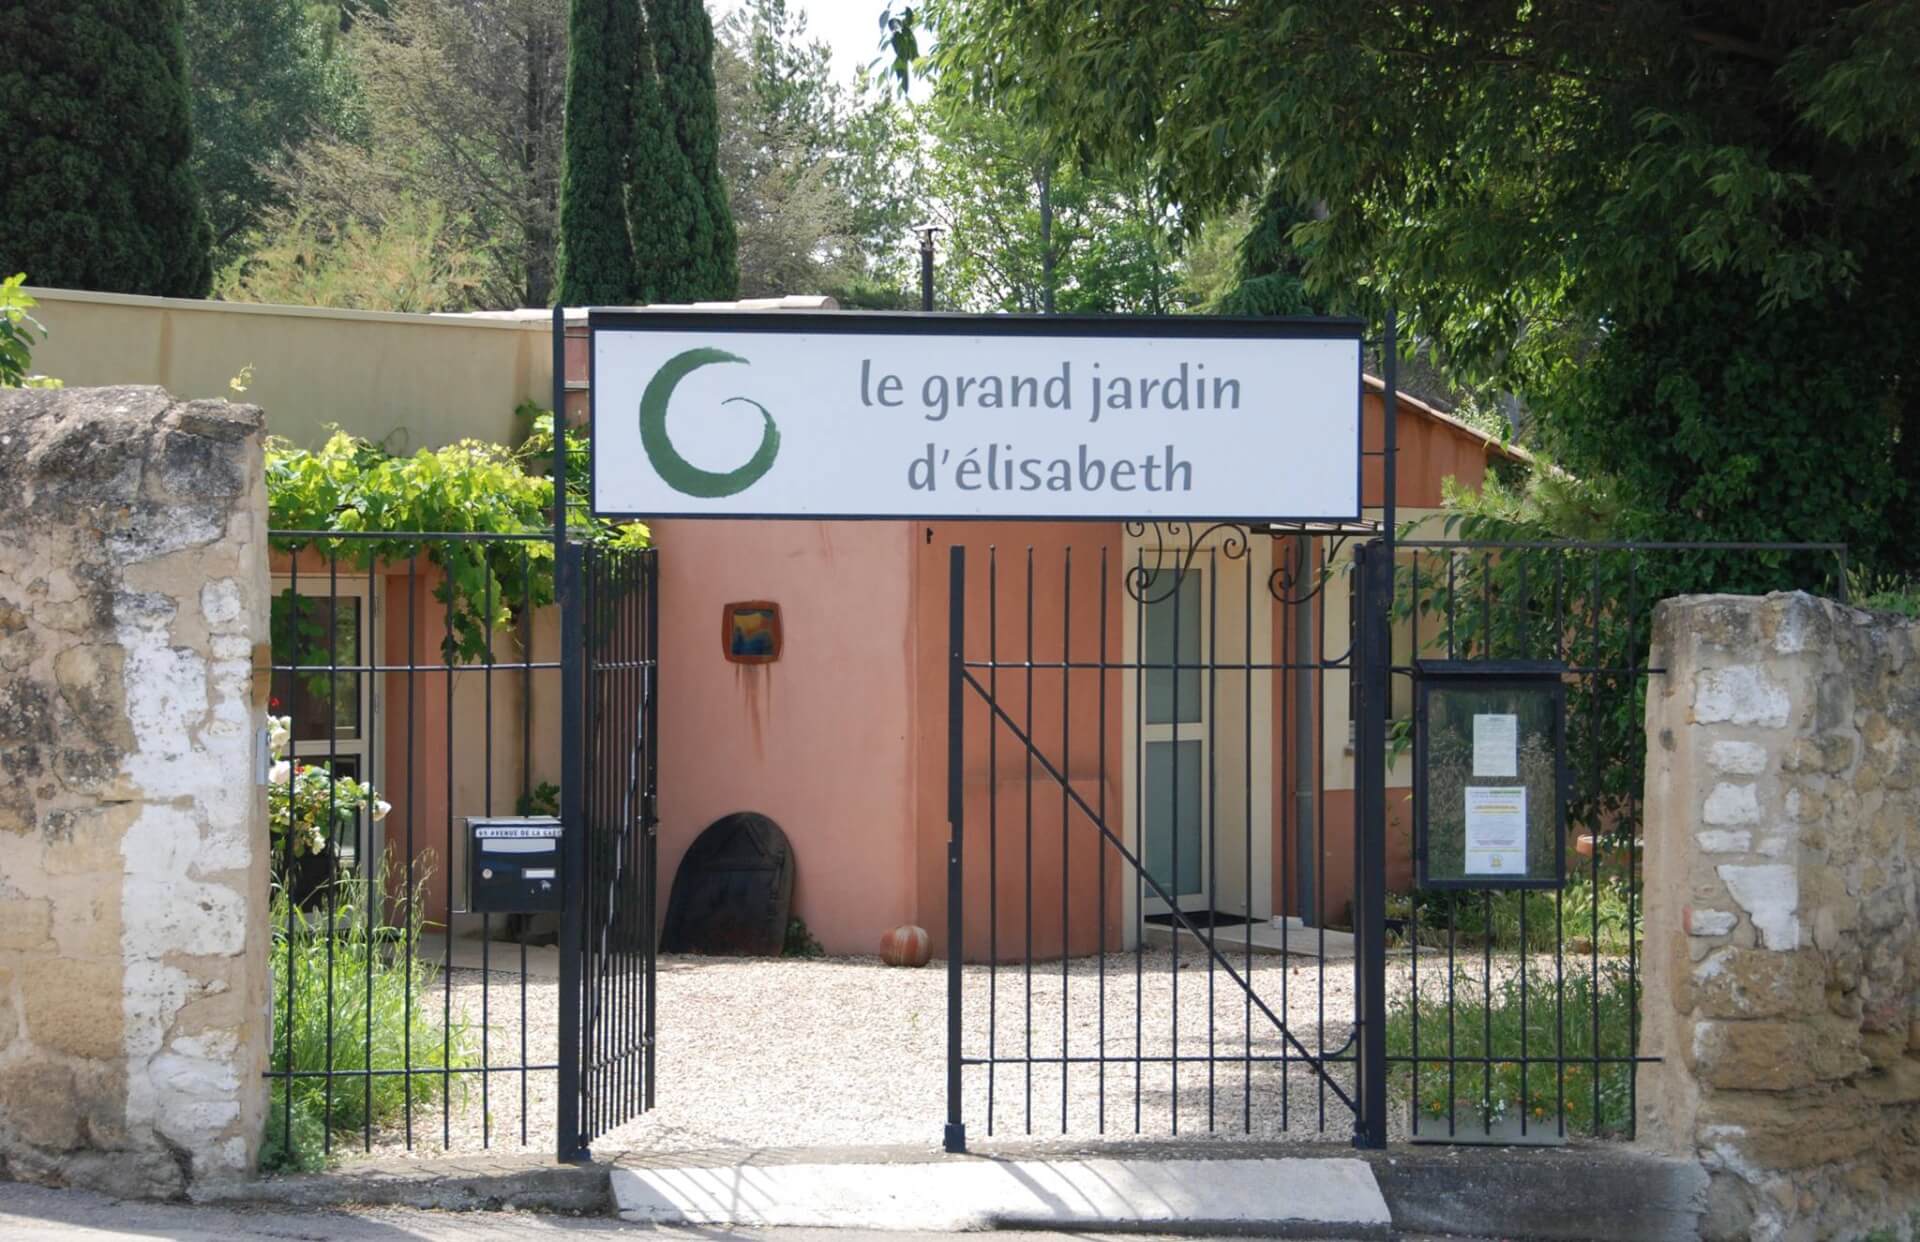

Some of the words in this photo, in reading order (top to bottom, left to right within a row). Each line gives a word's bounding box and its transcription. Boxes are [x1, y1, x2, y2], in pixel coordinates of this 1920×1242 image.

[860, 358, 904, 407] le
[921, 360, 1072, 423] grand
[1088, 361, 1241, 423] jardin
[907, 442, 1193, 492] d'élisabeth
[490, 829, 518, 837] AVENUE
[520, 829, 530, 837] DE
[531, 829, 541, 837] LA
